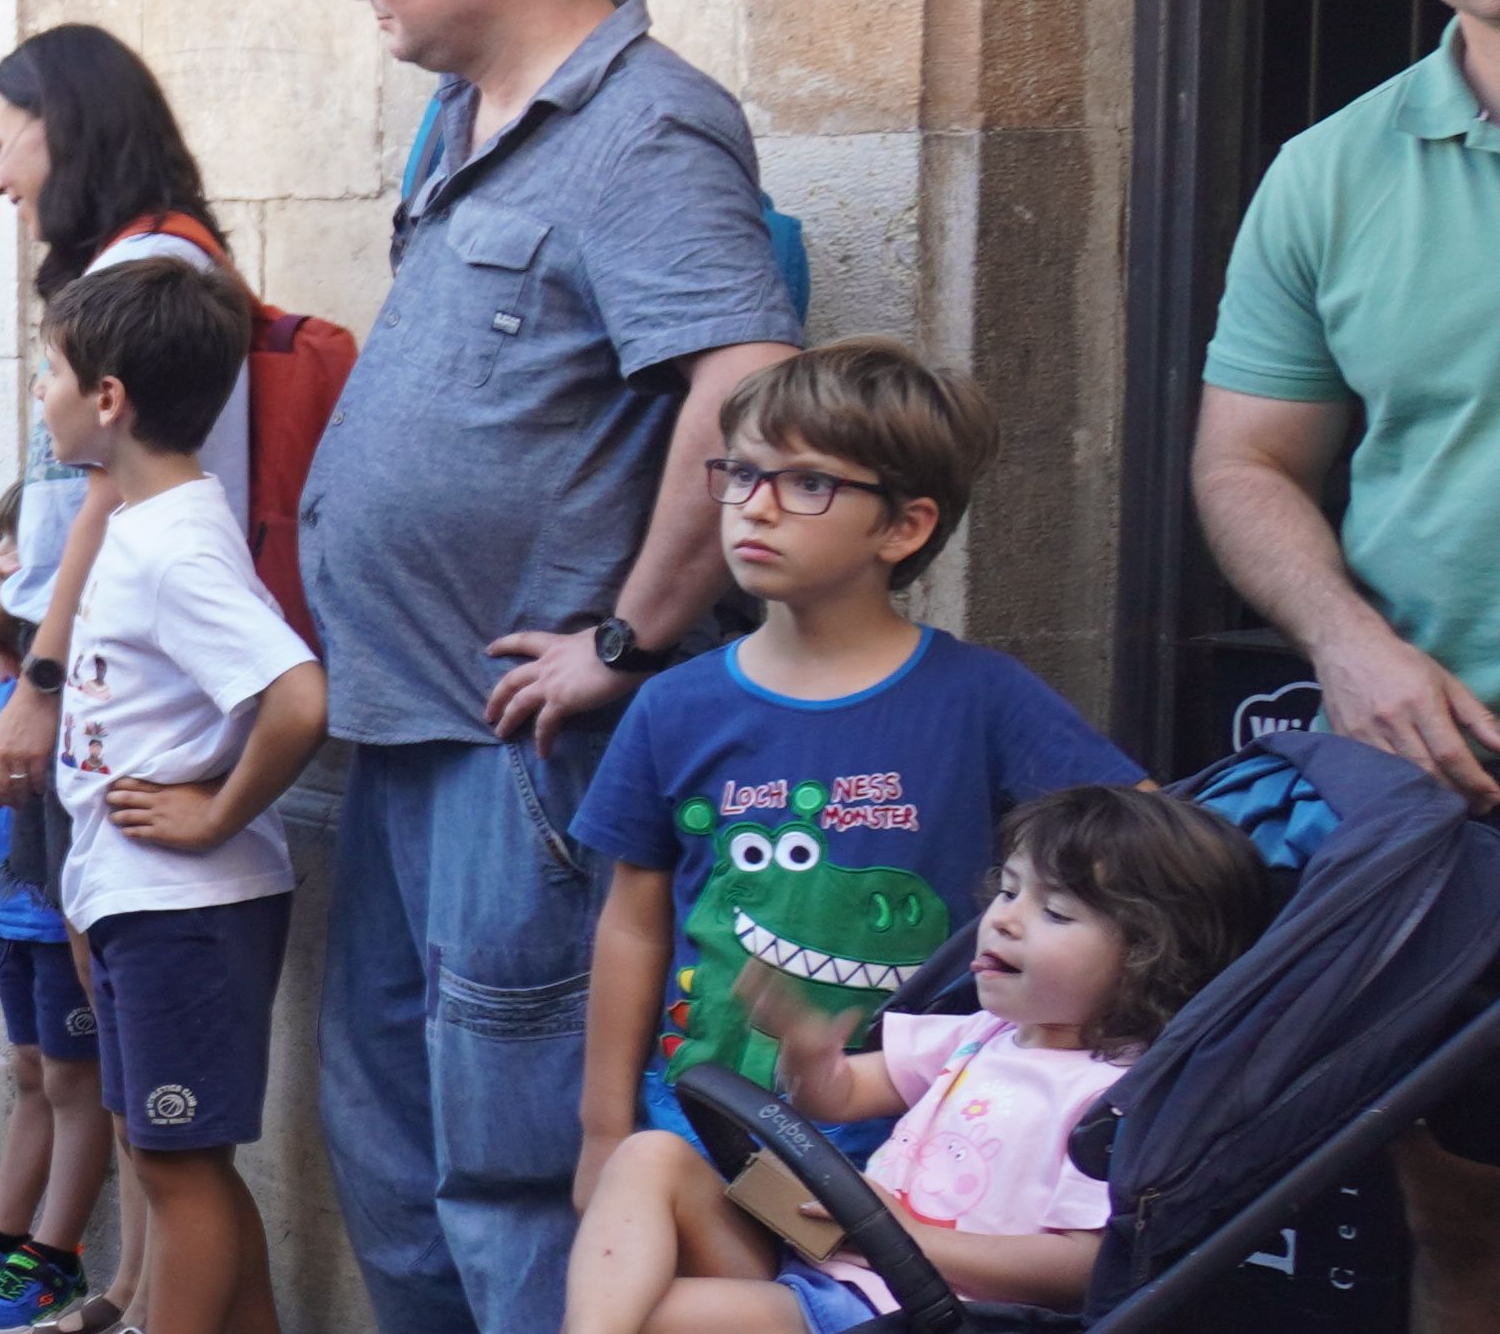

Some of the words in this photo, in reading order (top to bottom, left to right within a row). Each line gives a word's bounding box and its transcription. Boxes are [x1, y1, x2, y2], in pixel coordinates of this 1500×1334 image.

[720, 779, 789, 816] LOCH
[830, 771, 903, 804] NESS
[819, 803, 920, 832] MONSTER
[771, 1113, 816, 1153] cybex
